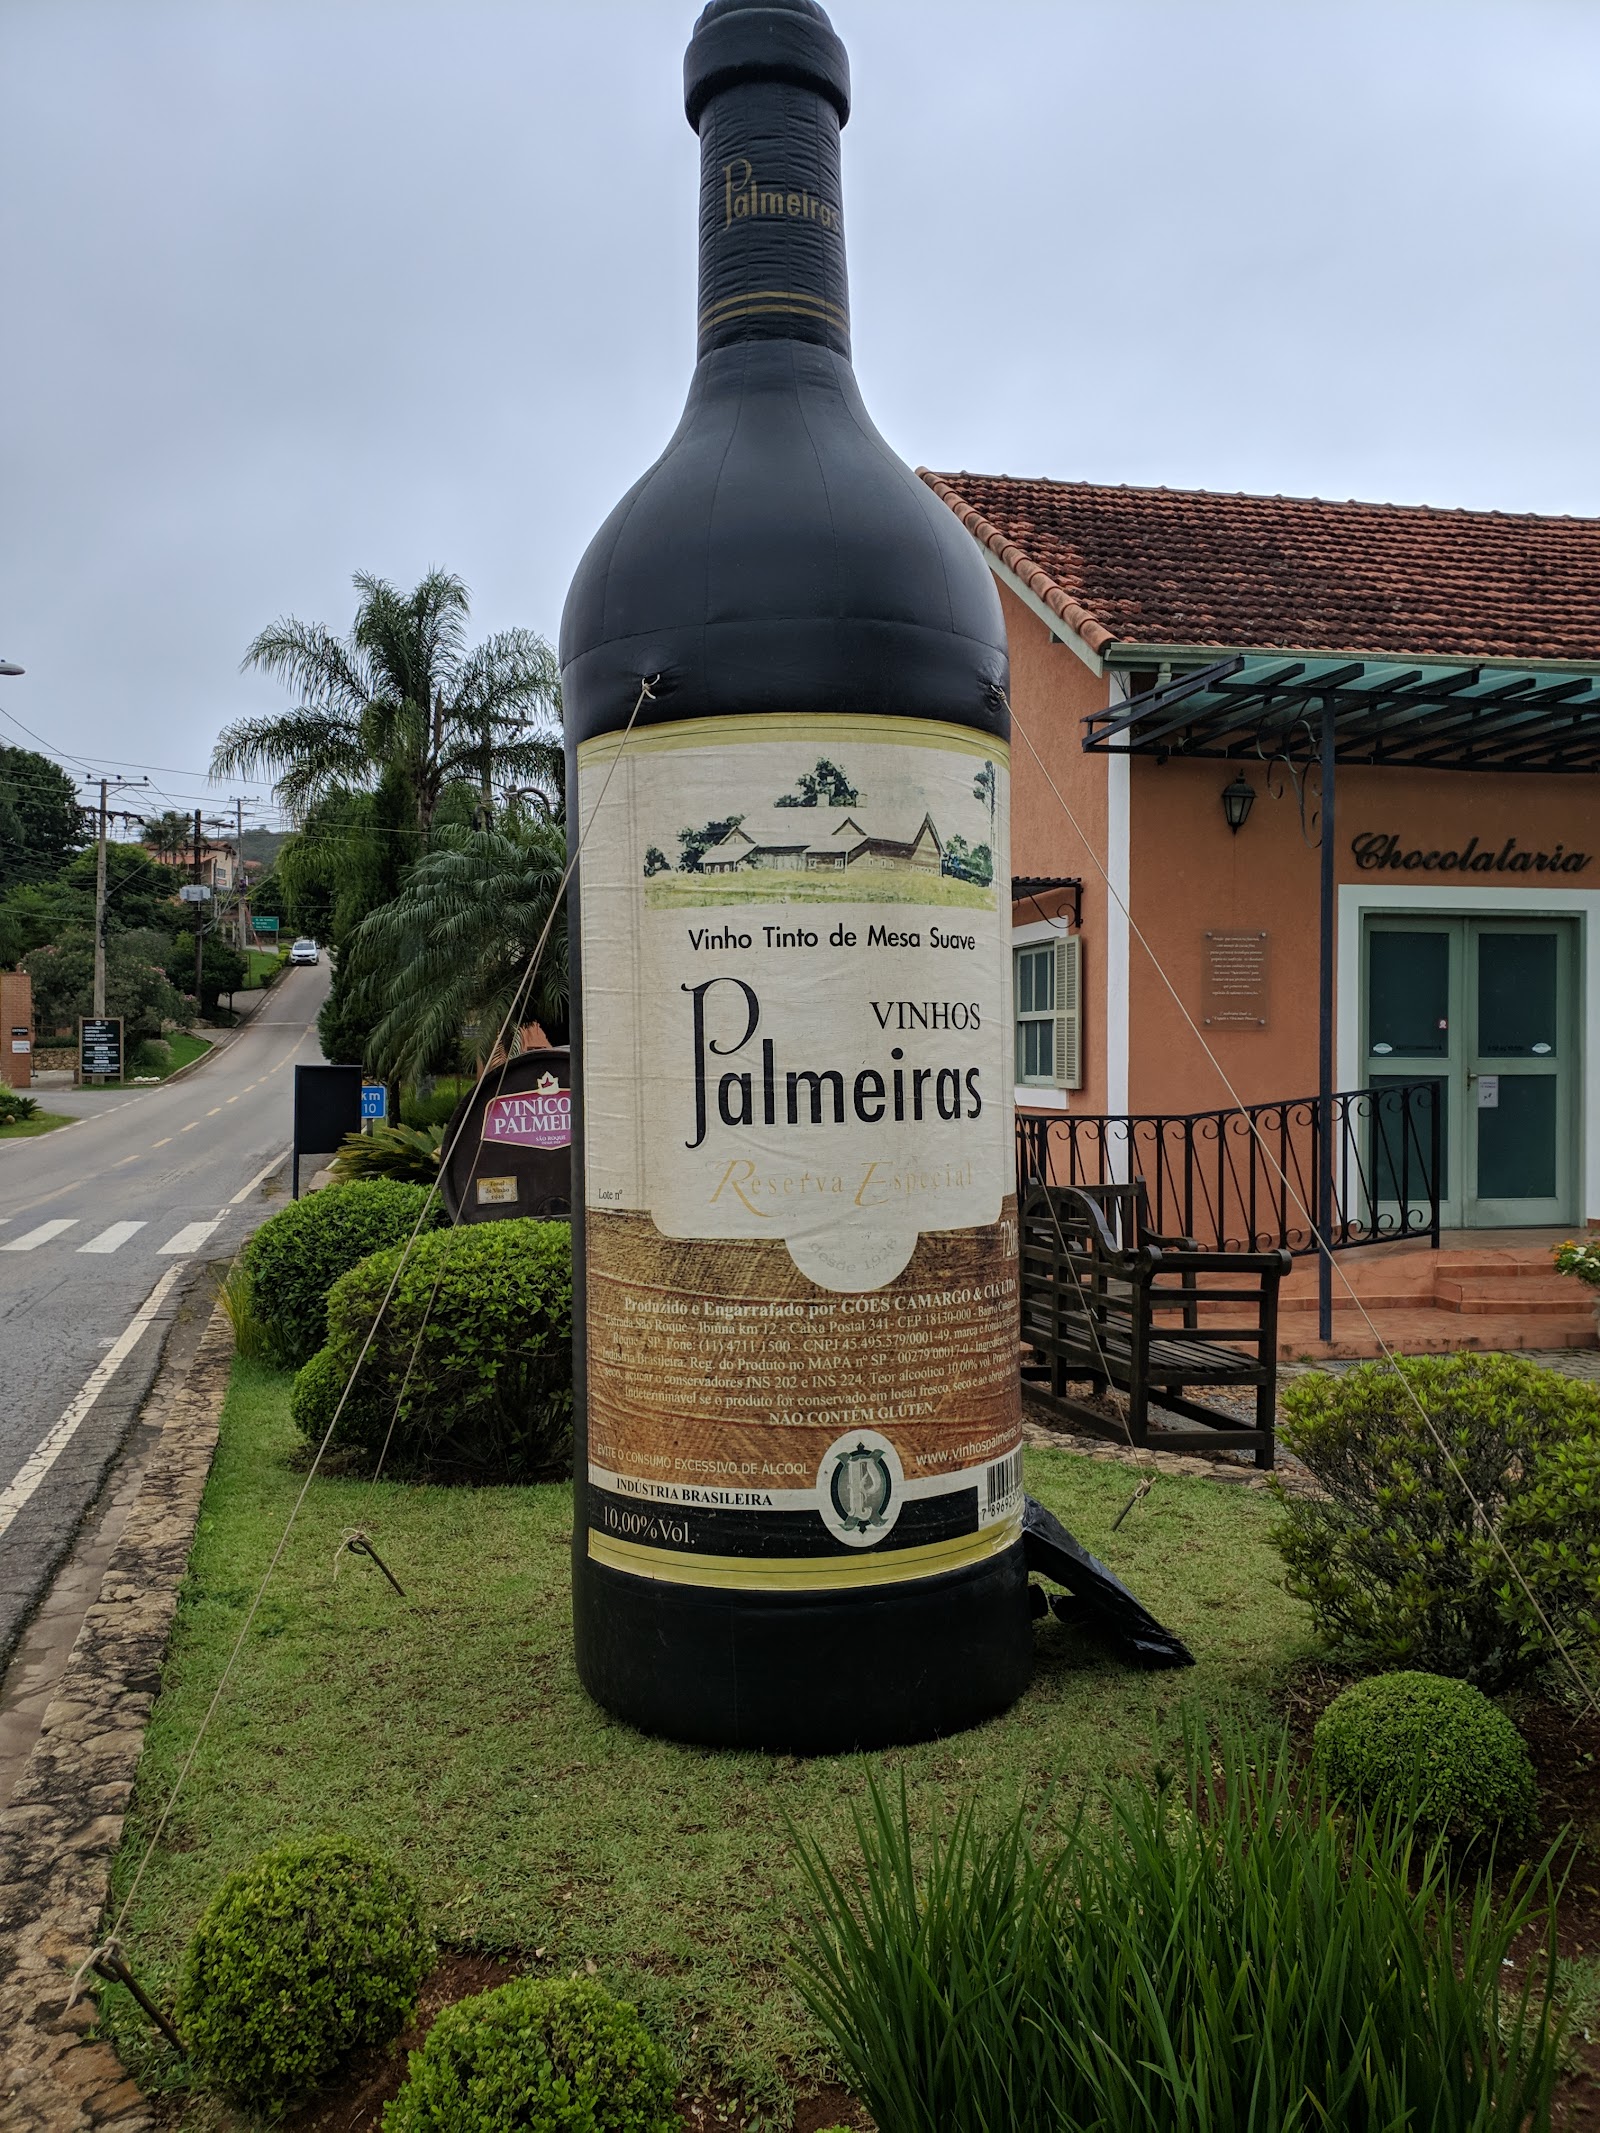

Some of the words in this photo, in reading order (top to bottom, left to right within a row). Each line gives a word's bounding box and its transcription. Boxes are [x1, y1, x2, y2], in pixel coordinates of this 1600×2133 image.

[722, 158, 839, 232] Palmeiras
[1351, 832, 1592, 872] Chocolataria
[688, 926, 752, 950] Vinho
[763, 926, 818, 948] Tinto
[830, 923, 856, 947] de
[867, 925, 920, 948] Mesa
[930, 926, 975, 950] Suave
[869, 1001, 981, 1030] VINHOS
[681, 977, 982, 1149] Palmeiras
[361, 1091, 380, 1101] km
[364, 1103, 377, 1114] 10
[598, 1188, 613, 1200] Lote
[705, 1159, 844, 1217] Reserva
[854, 1160, 973, 1207] Especial
[624, 1296, 688, 1315] Produzido
[692, 1304, 700, 1315] e
[704, 1301, 804, 1320] Engarrafado
[809, 1304, 836, 1319] por
[841, 1295, 891, 1314] GÓES
[894, 1288, 971, 1311] CAMARGO
[973, 1287, 982, 1302] &
[984, 1284, 1000, 1298] CIA
[606, 1314, 633, 1328] Estrada
[636, 1317, 653, 1329] São
[655, 1319, 688, 1334] Roque
[699, 1321, 735, 1334] Ibiúna
[739, 1323, 758, 1334] km
[763, 1323, 777, 1335] 12
[789, 1322, 825, 1334] Caixa
[829, 1321, 866, 1333] Postal
[897, 1315, 921, 1328] CEP
[667, 1337, 696, 1350] Fone:
[700, 1340, 723, 1354] (11)
[726, 1340, 755, 1352] 4711
[761, 1340, 790, 1352] 1500
[803, 1339, 839, 1351] CNPJ
[954, 1326, 977, 1339] marca
[690, 1357, 715, 1372] Reg.
[719, 1358, 733, 1370] do
[737, 1358, 785, 1371] Produto
[789, 1361, 804, 1370] no
[808, 1356, 851, 1370] MAPA
[871, 1353, 887, 1366] SP
[664, 1375, 743, 1388] conservadores
[746, 1377, 770, 1389] INS
[775, 1376, 797, 1389] 202
[801, 1379, 808, 1388] e
[812, 1375, 836, 1388] INS
[840, 1374, 866, 1386] 224.
[870, 1371, 896, 1384] Teor
[899, 1366, 944, 1381] alcoólico
[700, 1396, 711, 1405] se
[715, 1397, 722, 1405] o
[725, 1395, 773, 1409] produto
[777, 1394, 794, 1406] for
[797, 1391, 866, 1406] conservado
[870, 1392, 887, 1401] em
[891, 1385, 916, 1400] local
[953, 1380, 971, 1392] seco
[769, 1410, 804, 1425] NÃO
[807, 1406, 875, 1424] CONTÉM
[877, 1400, 937, 1420] GLÚTEN.
[597, 1443, 616, 1460] EVITE
[617, 1449, 624, 1460] O
[626, 1451, 672, 1469] CONSUMO
[674, 1458, 737, 1475] EXCESSIVO
[741, 1462, 757, 1475] DE
[761, 1459, 811, 1476] ÁLCOOL
[616, 1477, 679, 1500] INDÚSTRIA
[682, 1489, 773, 1507] BRASILEIRA
